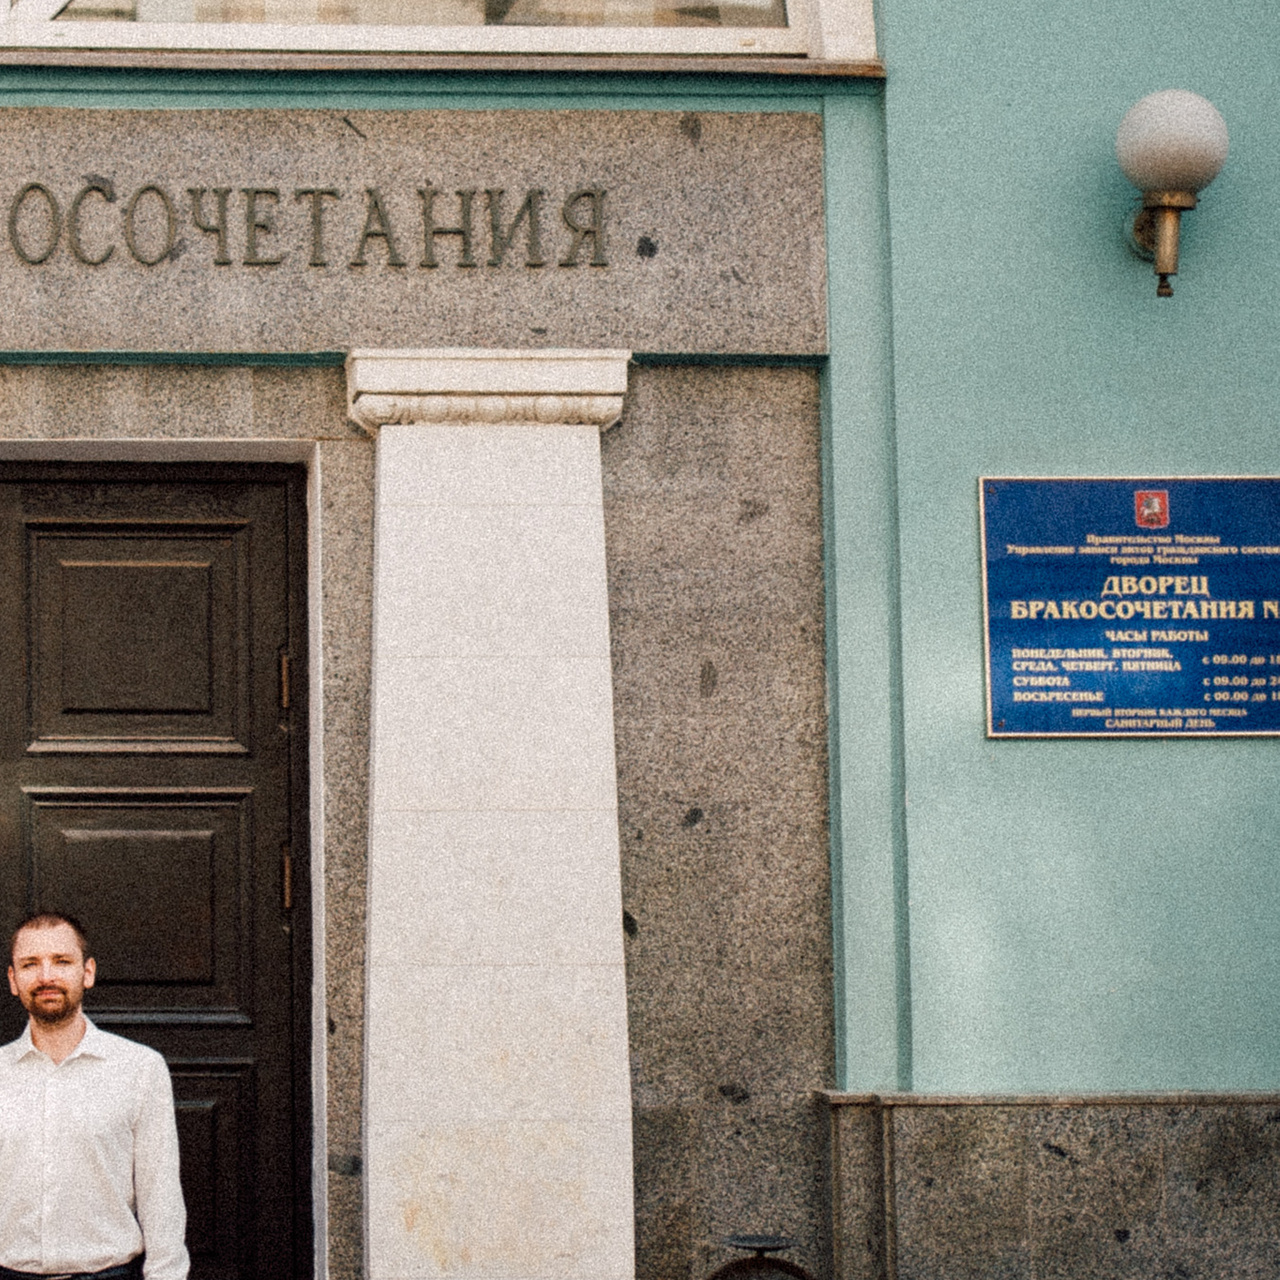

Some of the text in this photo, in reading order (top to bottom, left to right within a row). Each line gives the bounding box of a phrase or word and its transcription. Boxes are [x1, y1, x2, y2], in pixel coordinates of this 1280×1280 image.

[1174, 534, 1221, 544] Москвы
[1153, 554, 1199, 565] Москвы
[1100, 576, 1211, 598] ДВОРЕЦ
[1010, 600, 1255, 620] БРАКОСОЧЕТАНИЯ
[1105, 630, 1209, 642] ЧАСЫ РАБОТЫ
[1121, 661, 1182, 673] ПЯТНИЦА
[1012, 675, 1071, 687] СУББОТА
[1013, 691, 1104, 702] ВОСКРЕСЕНЬЕ
[1105, 717, 1216, 729] САНИТАРНЫЙ ДЕНЬ
